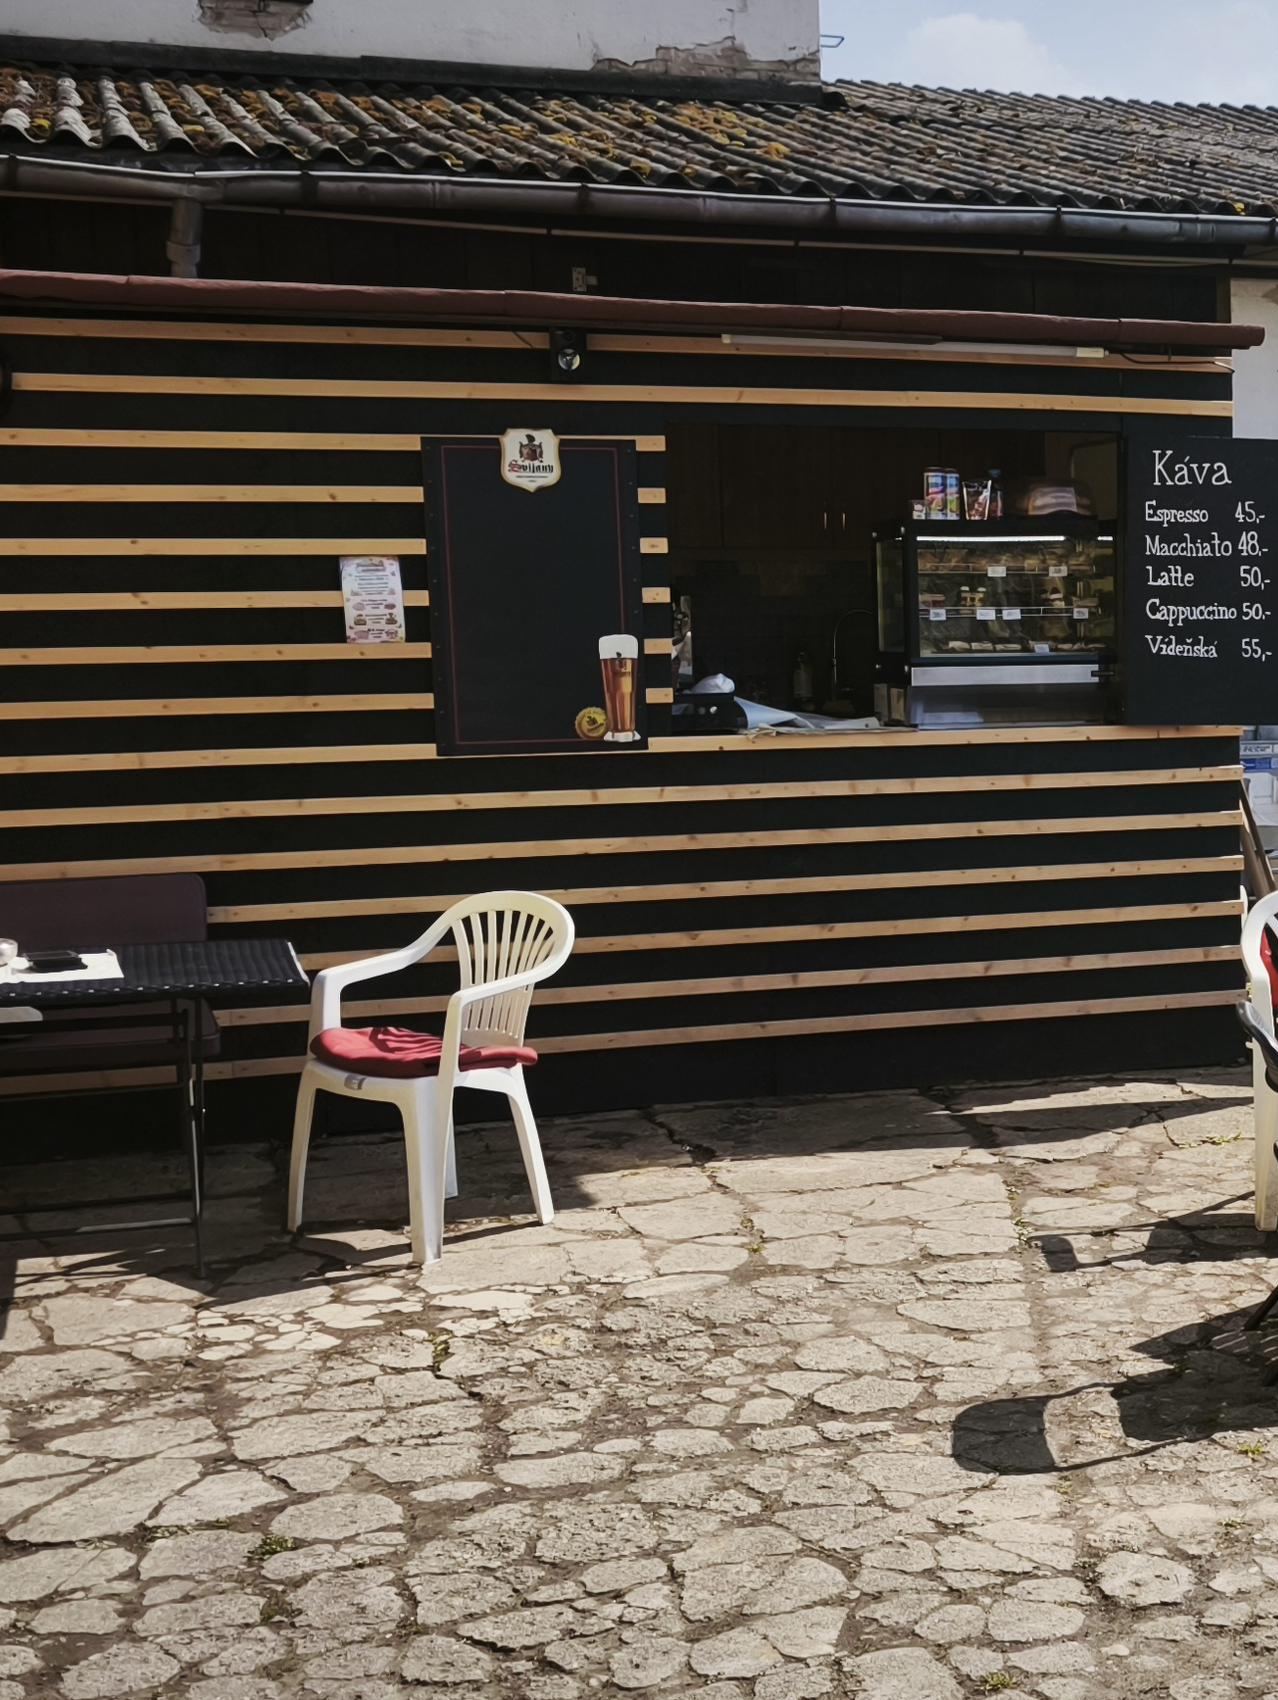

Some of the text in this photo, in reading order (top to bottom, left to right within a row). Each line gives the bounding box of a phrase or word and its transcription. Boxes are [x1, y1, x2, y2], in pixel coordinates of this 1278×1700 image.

[1152, 449, 1233, 486] Káva
[1145, 499, 1266, 527] Espresso 45,-
[1145, 531, 1233, 557] Macchiato
[1145, 565, 1271, 591] Latte 50,-
[1145, 598, 1237, 627] Cappuccino
[1144, 634, 1273, 662] Vídeňská 55,-
